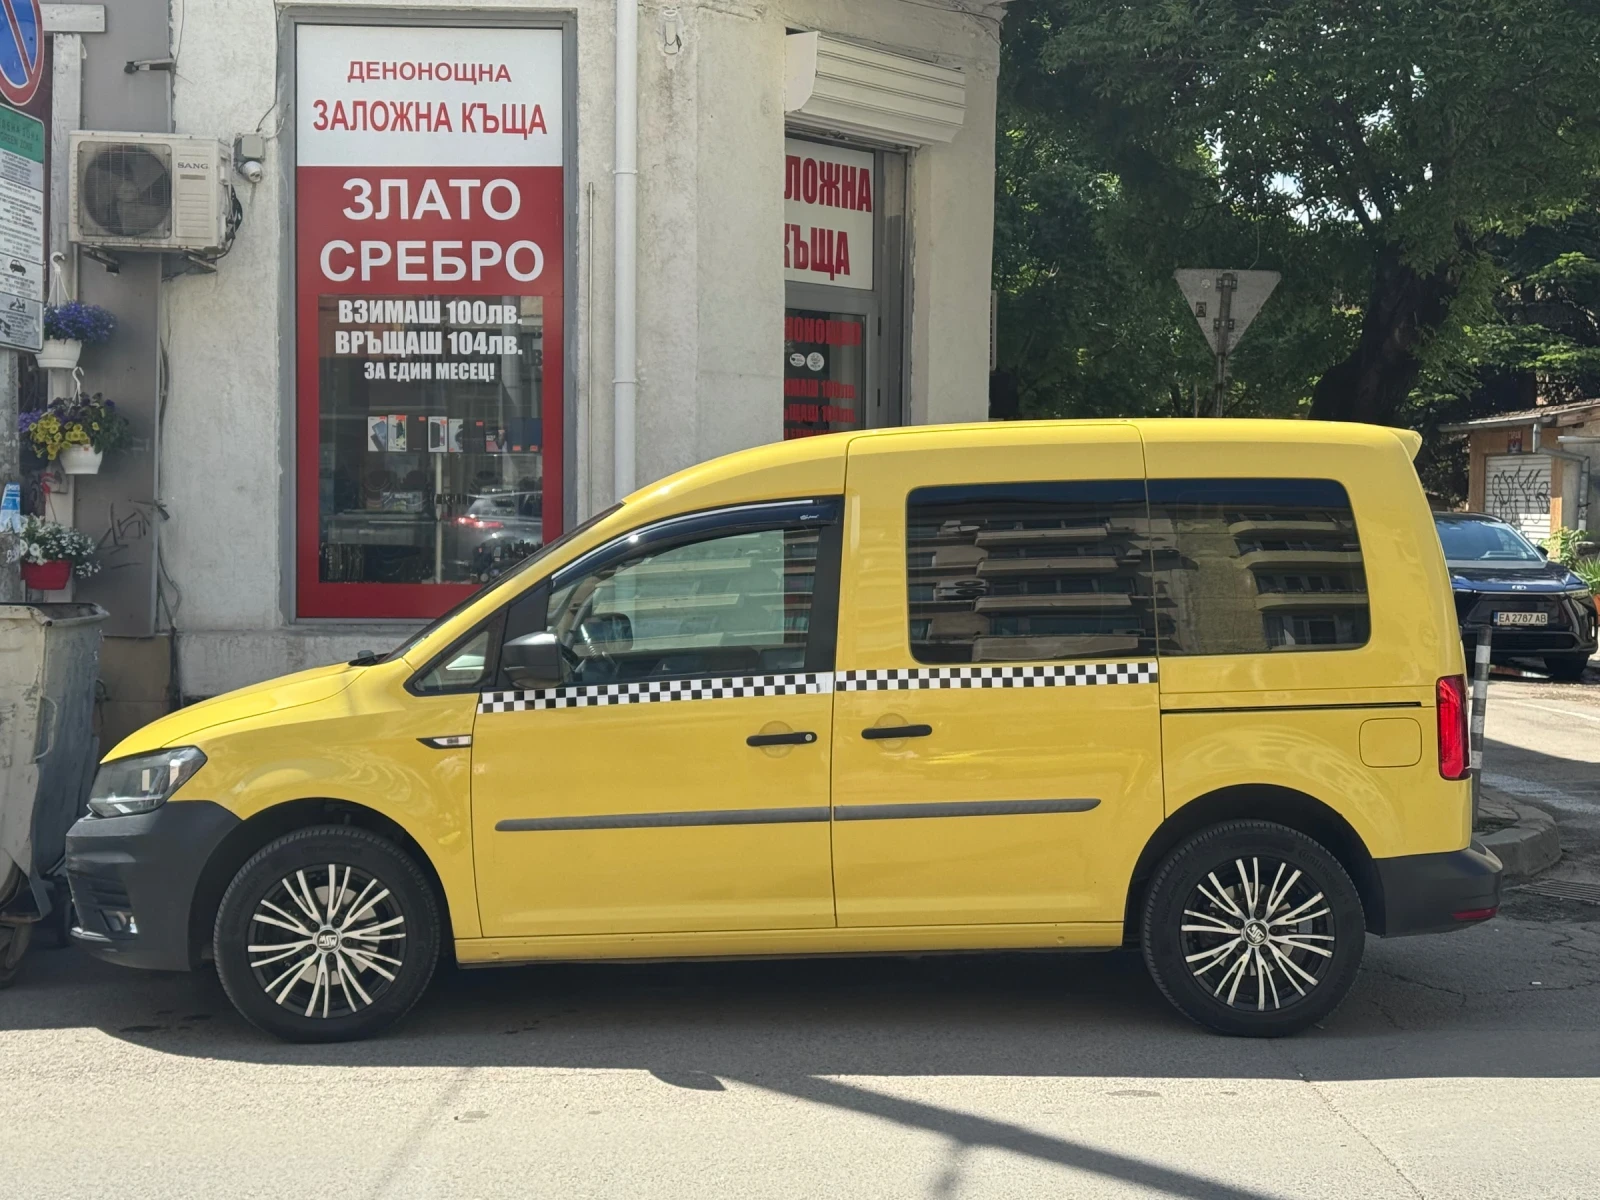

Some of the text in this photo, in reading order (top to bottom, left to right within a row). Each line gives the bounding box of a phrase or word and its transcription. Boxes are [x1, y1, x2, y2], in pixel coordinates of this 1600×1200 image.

[347, 61, 512, 85] ДЕНОНОЩНА
[313, 99, 548, 140] ЗАЛОЖНА КЪЩА
[342, 178, 521, 220] ЗЛАТО
[320, 240, 545, 282] СРЕБРО
[338, 300, 523, 325] ВЗИМАШ 100лв.
[335, 331, 523, 358] ВРЪЩАШ 104лв.
[364, 362, 495, 382] ЗА ЕДИН МЕСЕЦ!
[1498, 613, 1547, 623] EA 2787 AB
[318, 935, 338, 947] MSW
